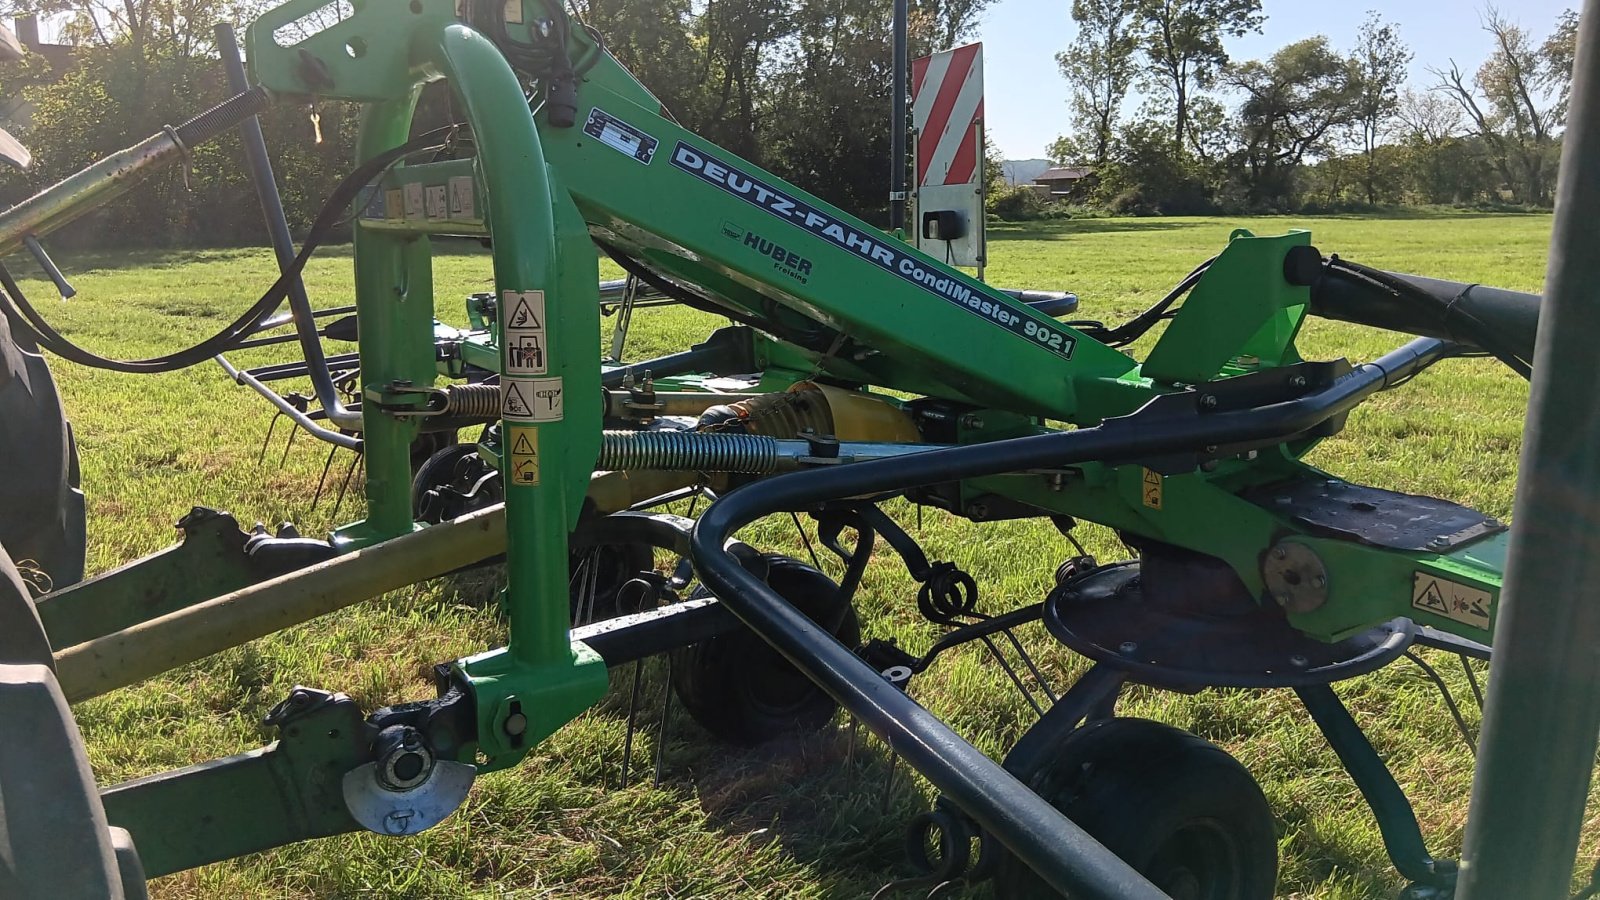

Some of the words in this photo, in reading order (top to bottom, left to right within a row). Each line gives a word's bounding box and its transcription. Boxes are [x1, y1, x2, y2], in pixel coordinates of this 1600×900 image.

[675, 147, 895, 267] DEUTZ-FAHR
[899, 258, 1020, 327] CondiMaster
[1024, 320, 1072, 354] 9021
[743, 231, 813, 276] HUBER
[773, 262, 807, 285] Freising
